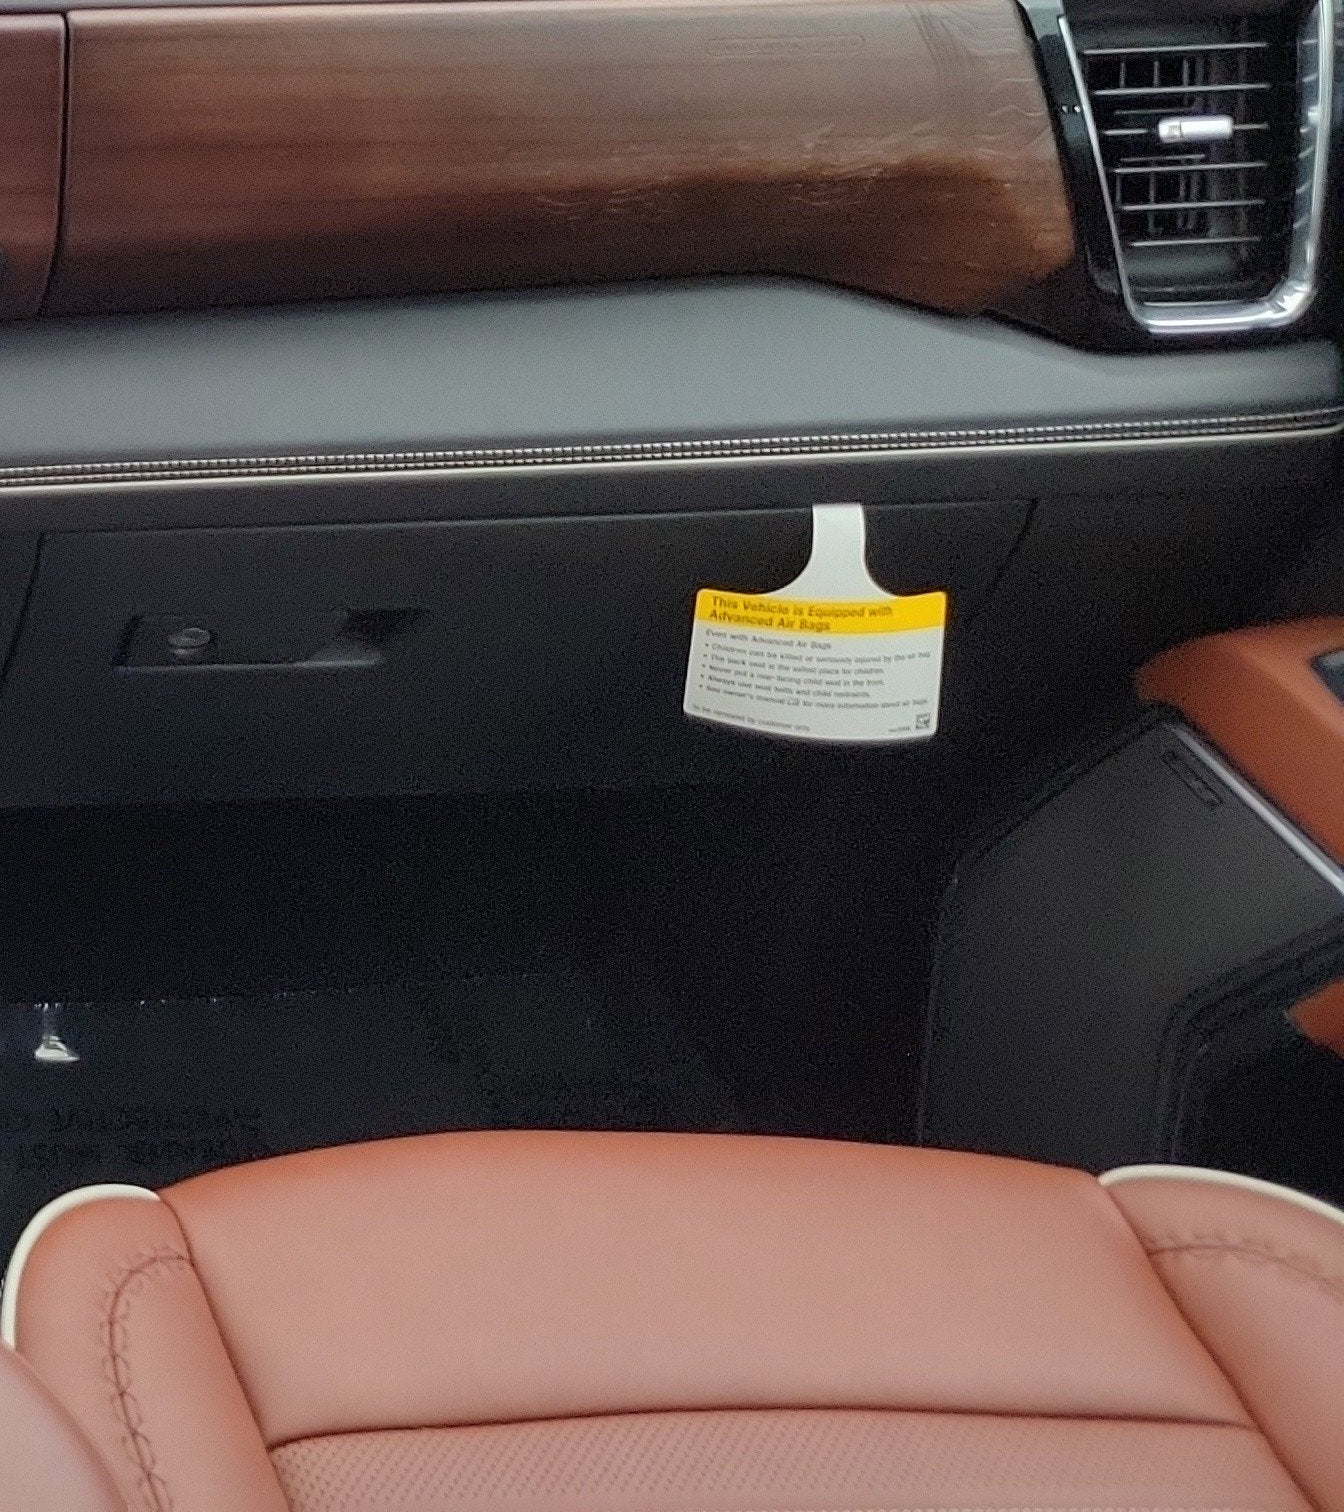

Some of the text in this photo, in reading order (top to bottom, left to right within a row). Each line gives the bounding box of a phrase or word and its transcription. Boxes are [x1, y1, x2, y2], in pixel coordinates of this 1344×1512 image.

[712, 596, 739, 610] This
[743, 600, 789, 616] Vehicle
[808, 605, 864, 619] Equipped
[868, 604, 893, 617] with
[708, 610, 773, 627] Advanced
[777, 617, 794, 628] Air
